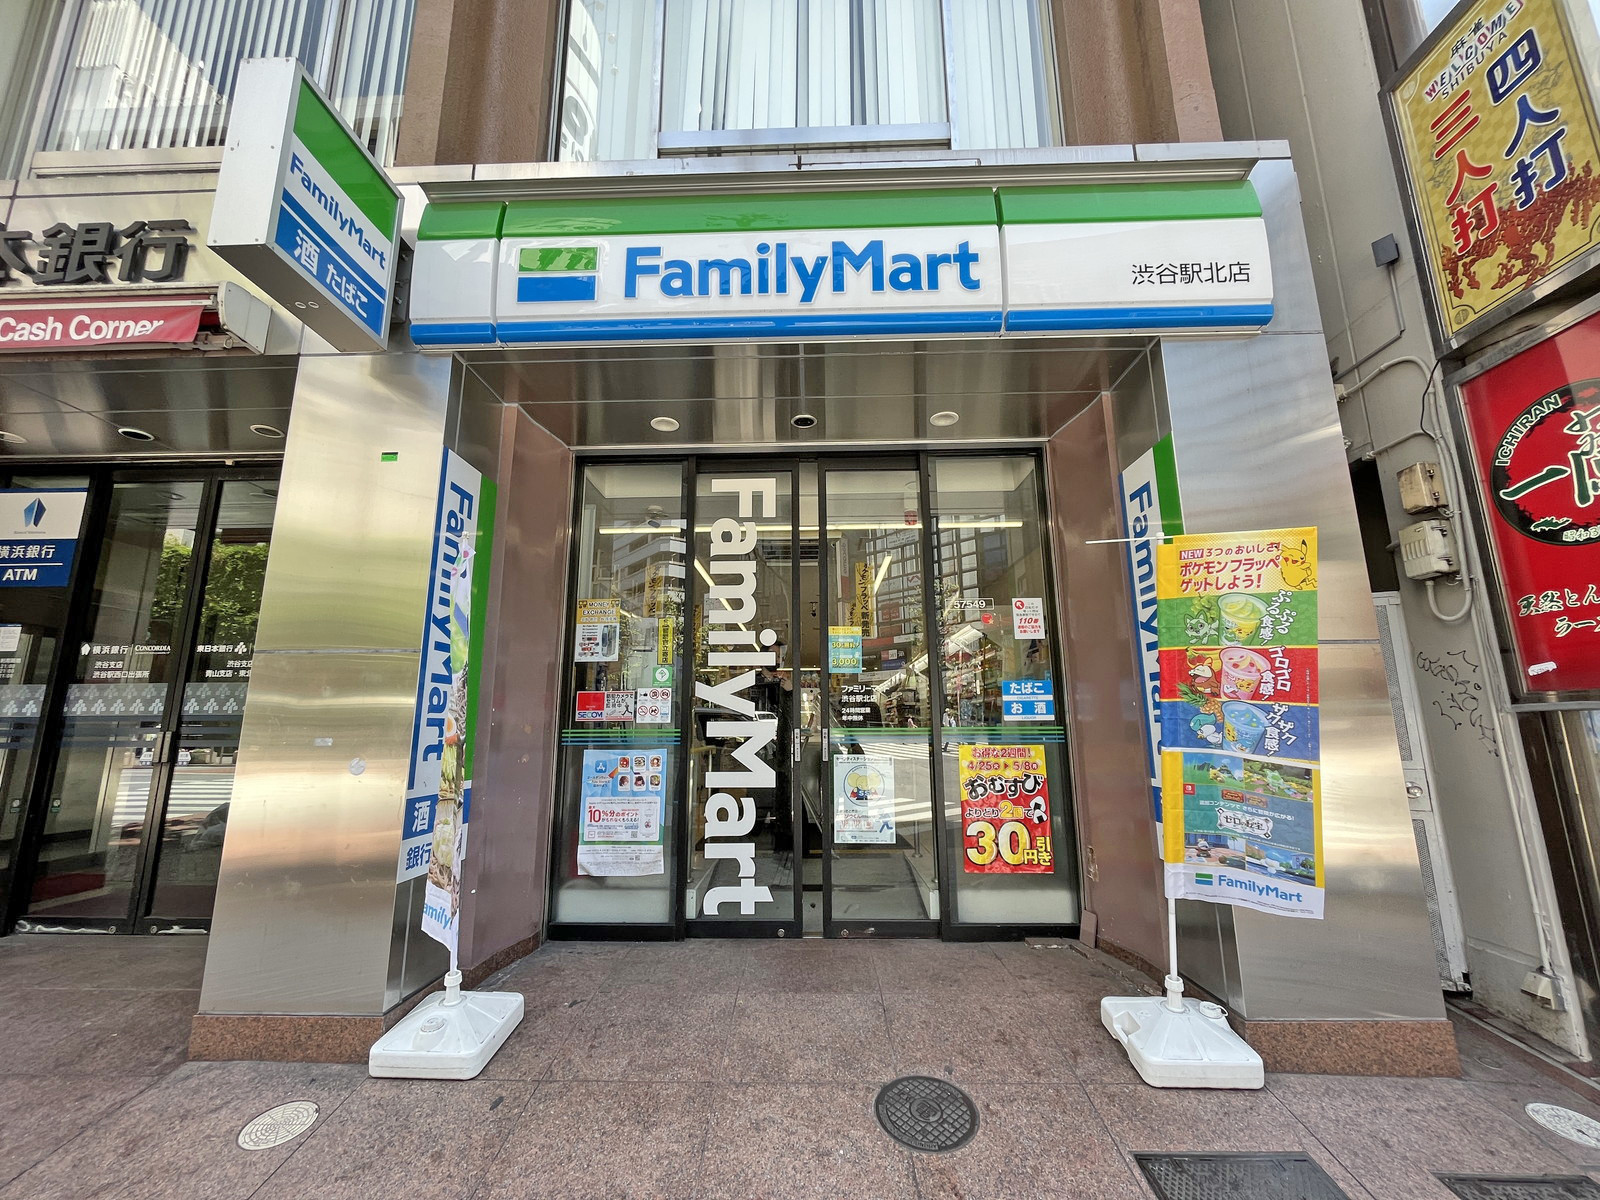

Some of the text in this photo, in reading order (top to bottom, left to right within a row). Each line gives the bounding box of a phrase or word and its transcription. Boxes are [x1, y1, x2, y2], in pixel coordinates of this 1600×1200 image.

[1424, 0, 1522, 100] WELCOME
[1441, 31, 1508, 100] SHIBUYA
[1485, 27, 1569, 211] 四人打
[1429, 88, 1500, 256] 三人打
[289, 151, 387, 271] FamilyMart
[293, 228, 369, 319] 酒 たばこ
[624, 239, 981, 304] FamilyMart
[1130, 261, 1251, 286] 渋谷駅北店
[0, 314, 165, 342] Cash Corner
[1496, 393, 1562, 467] ICHIRAN
[1562, 524, 1600, 542] 昭和3
[0, 544, 56, 559] 横浜銀行
[1180, 554, 1281, 577] ポケモンフラッペ
[1181, 549, 1204, 560] NEW
[2, 568, 38, 581] ATM
[1180, 573, 1262, 593] ゲットしよう!
[953, 600, 986, 609] 57549
[1266, 589, 1297, 635] ぷるぷる
[92, 645, 129, 655] 横浜銀行
[1268, 645, 1292, 692] ゴロゴロ
[695, 477, 778, 916] FamilyMart
[841, 685, 890, 693] ファミリーマト
[1009, 682, 1045, 695] たばこ
[577, 711, 603, 719] SECOM
[1265, 702, 1297, 746] ザクザク
[963, 772, 1043, 800] おむすび
[411, 800, 432, 833] 酒
[1217, 874, 1303, 903] FamilyMart
